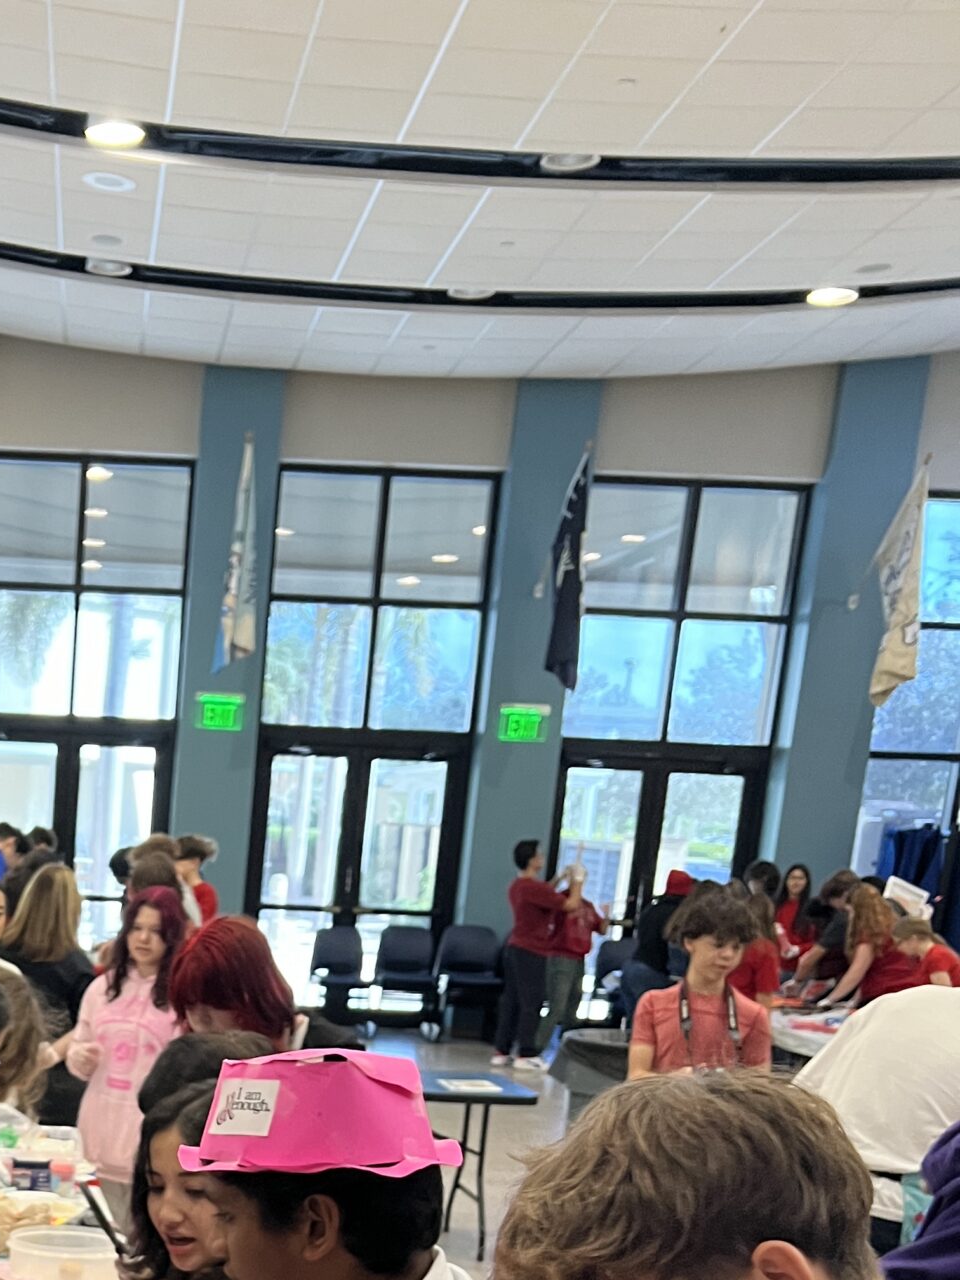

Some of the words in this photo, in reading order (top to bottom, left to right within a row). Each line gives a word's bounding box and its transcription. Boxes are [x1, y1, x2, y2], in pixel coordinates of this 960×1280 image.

[236, 1087, 243, 1100] I
[244, 1091, 262, 1101] am
[231, 1099, 271, 1115] enough.
